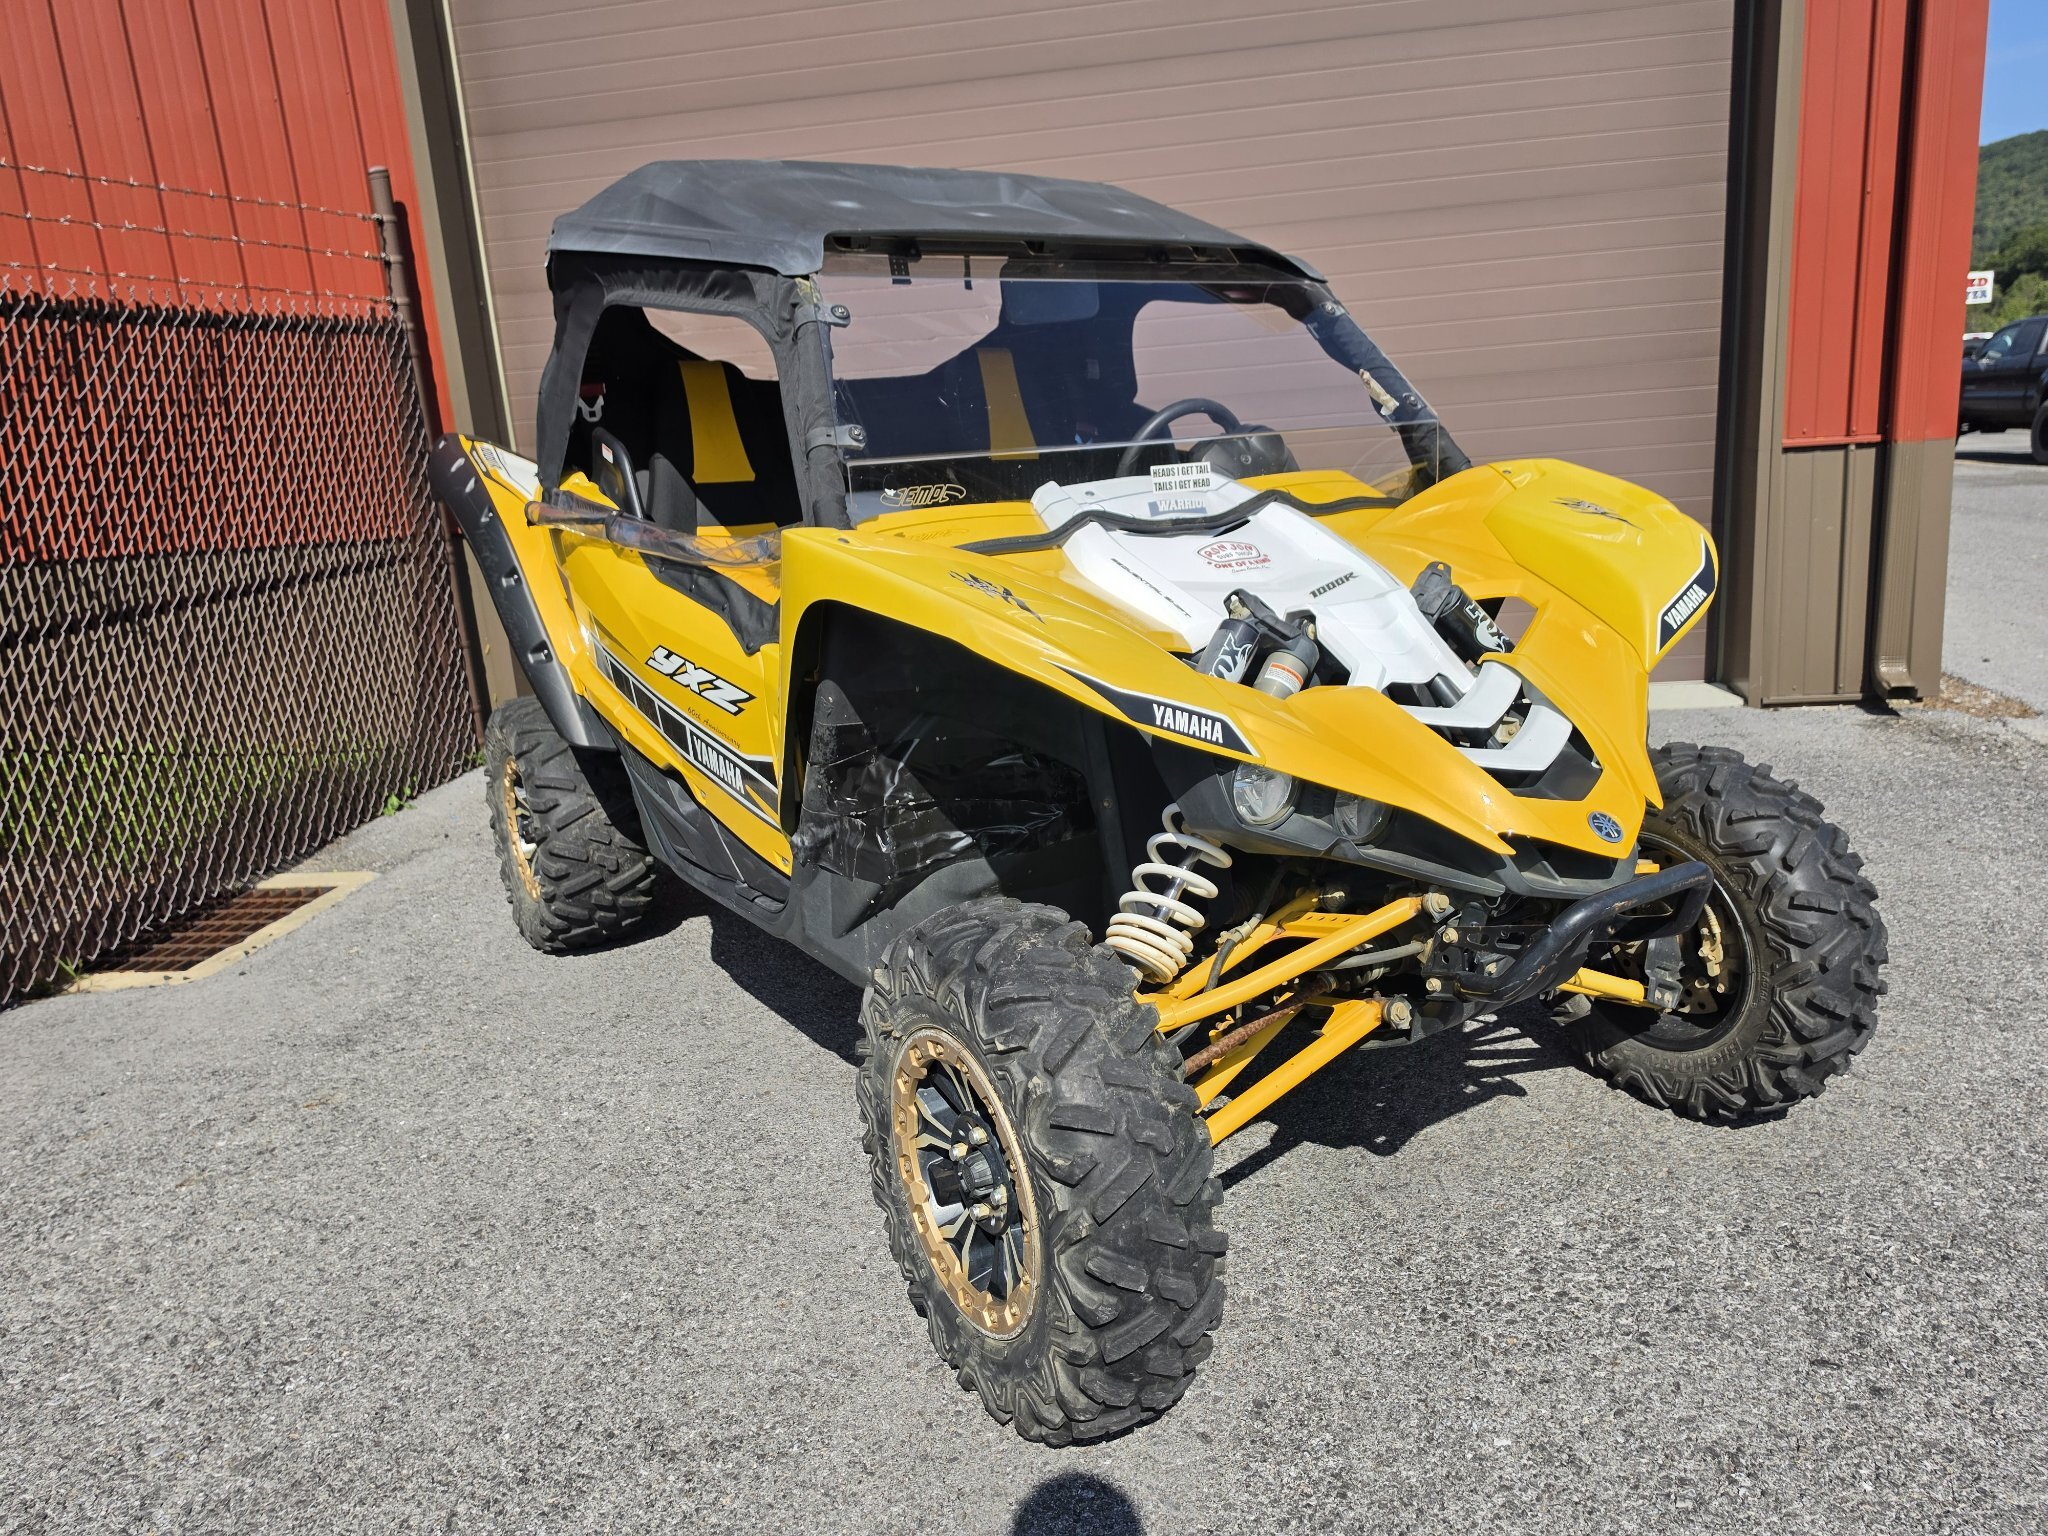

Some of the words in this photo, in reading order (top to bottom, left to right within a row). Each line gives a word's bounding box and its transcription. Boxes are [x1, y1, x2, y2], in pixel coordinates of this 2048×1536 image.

[1152, 468, 1176, 479] HEADS
[1181, 466, 1194, 476] GET
[1195, 464, 1210, 475] TAIL
[1153, 481, 1173, 492] TAILS
[1178, 479, 1191, 490] GET
[1192, 478, 1211, 489] HEAD
[1204, 544, 1228, 558] RON
[1230, 543, 1253, 552] JON
[1309, 571, 1359, 599] 1000R
[1663, 583, 1708, 630] YAMAHA
[645, 645, 757, 716] YXZ
[1152, 703, 1224, 744] YAMAHA
[692, 734, 745, 795] YAMAHA
